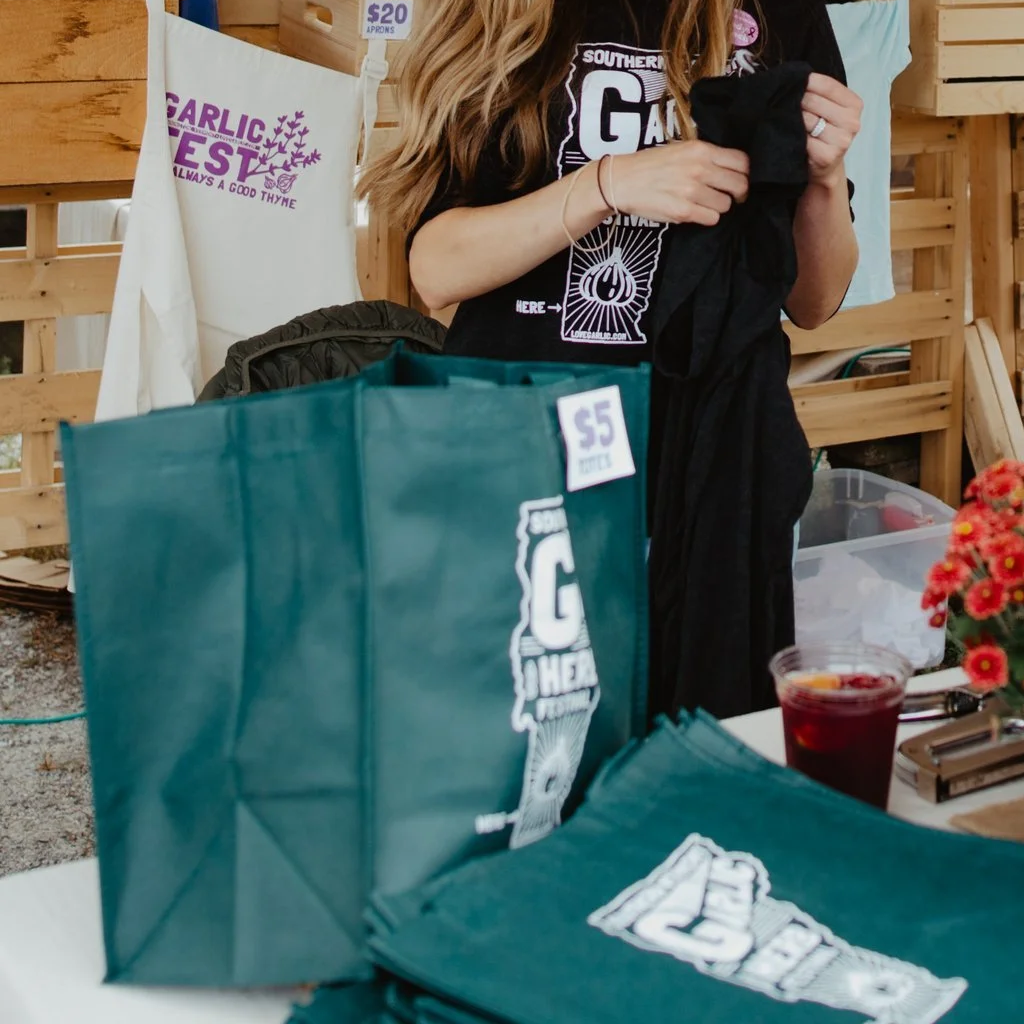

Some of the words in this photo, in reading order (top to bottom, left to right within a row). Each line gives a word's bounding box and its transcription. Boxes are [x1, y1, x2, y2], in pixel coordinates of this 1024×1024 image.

[367, 2, 408, 25] $20
[366, 25, 395, 34] APRONS
[166, 92, 266, 144] GARLIC
[168, 126, 259, 183] EST
[217, 180, 225, 190] A
[229, 182, 257, 198] GOOD
[260, 190, 297, 210] THYME
[516, 300, 546, 314] HERE
[573, 399, 616, 451] $5
